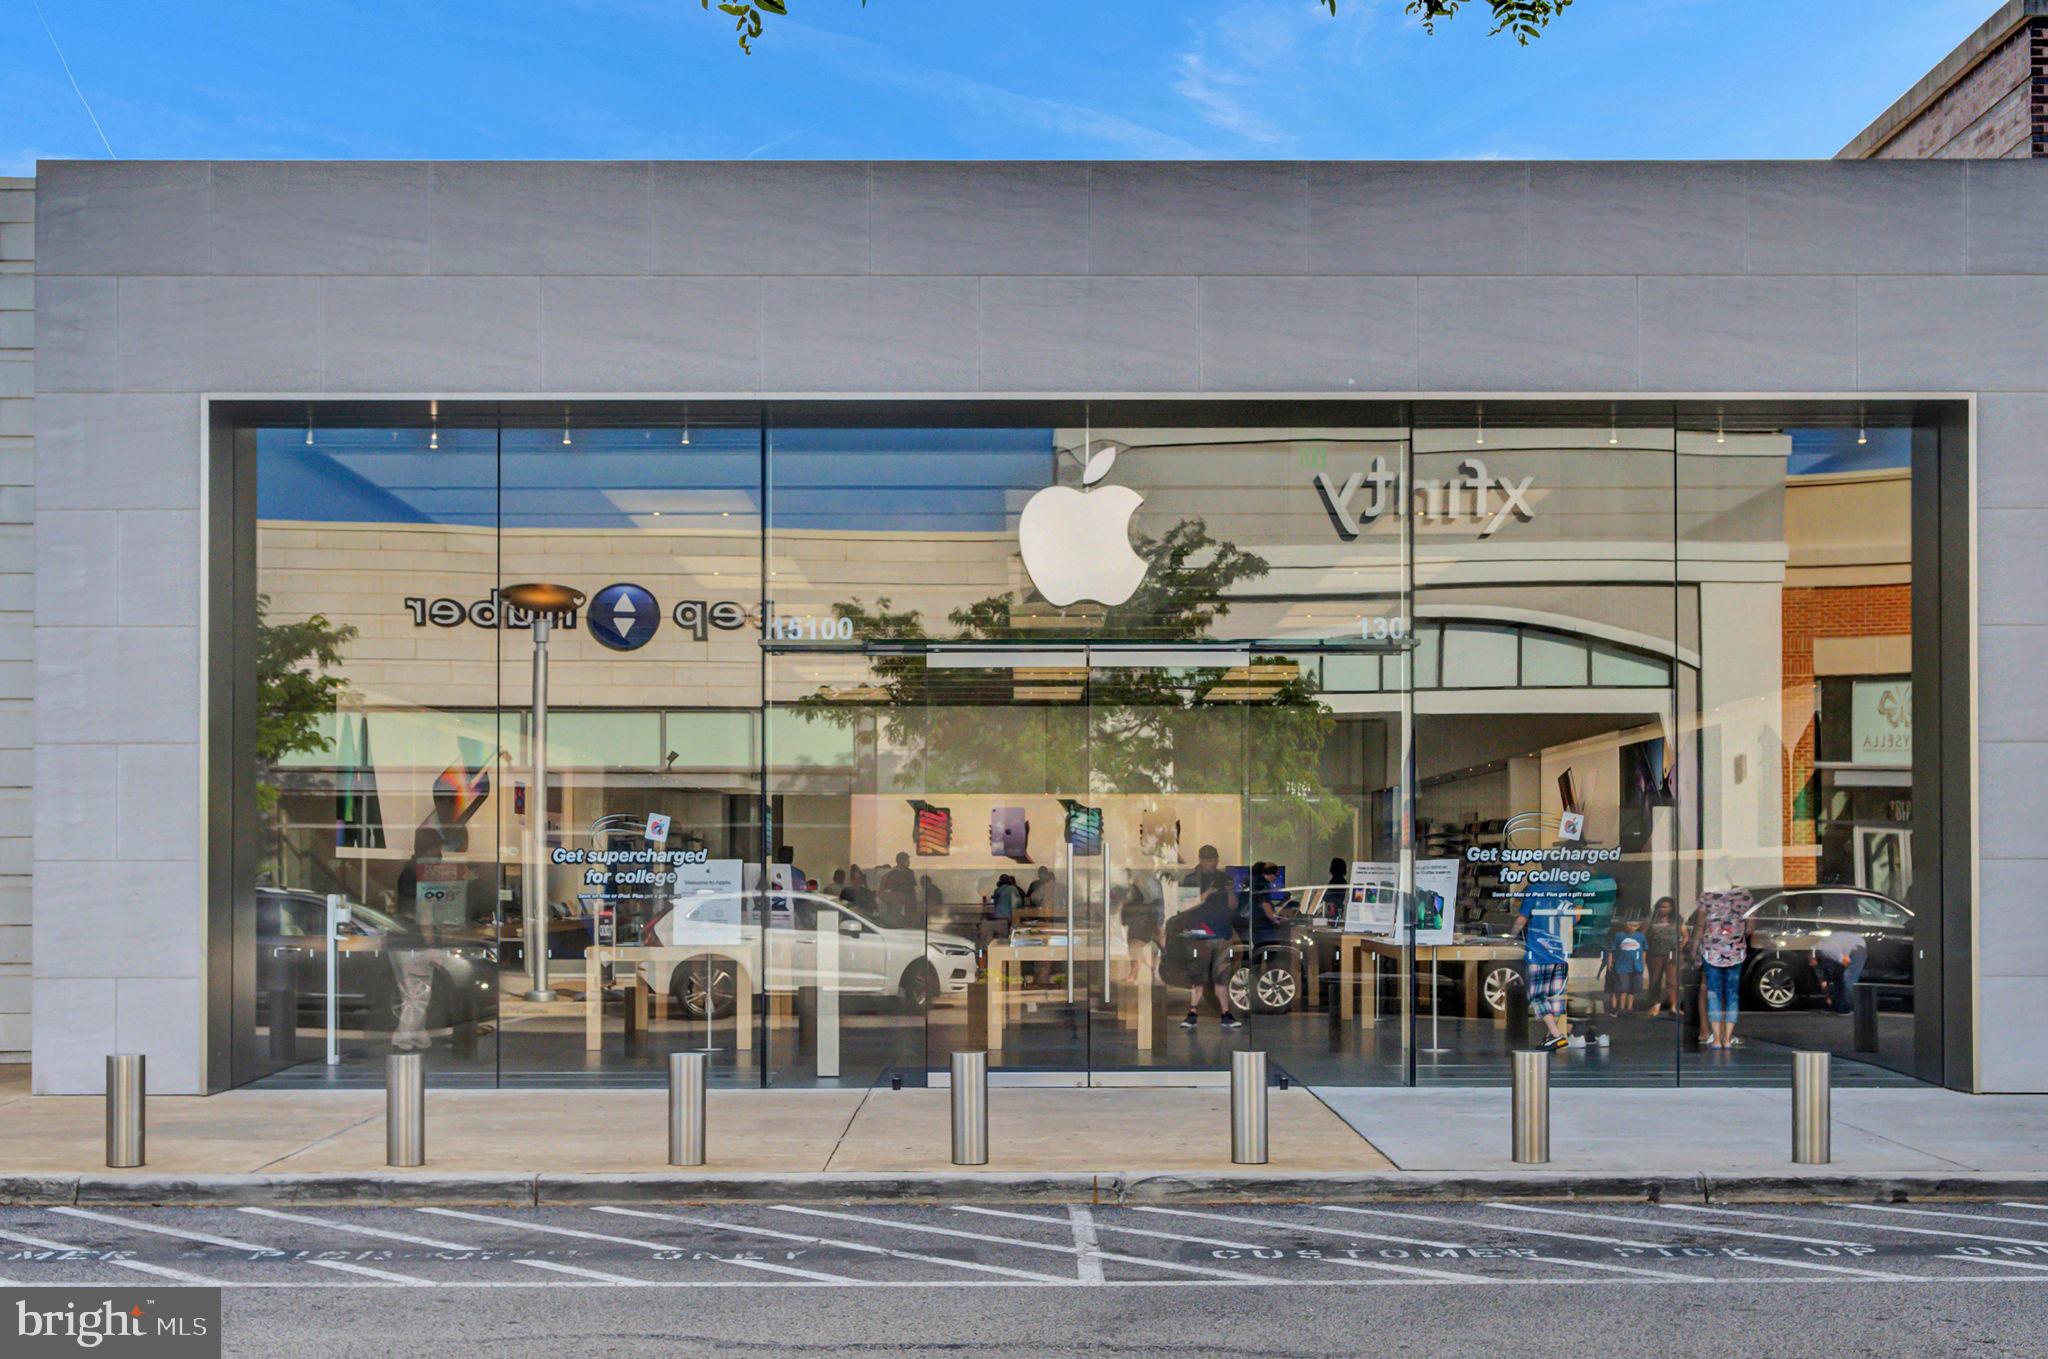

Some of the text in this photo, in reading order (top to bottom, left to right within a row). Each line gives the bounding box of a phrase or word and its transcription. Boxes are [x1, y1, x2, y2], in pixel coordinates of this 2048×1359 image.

[773, 616, 854, 641] 15100
[1359, 616, 1406, 640] 130
[552, 848, 707, 867] Get supercharged
[1466, 847, 1622, 867] Get supercharged
[585, 869, 677, 886] for college
[1499, 868, 1591, 885] for college
[1212, 1248, 1538, 1260] CUSTOMER
[1614, 1248, 1750, 1258] PICK
[1804, 1247, 1876, 1257] UP
